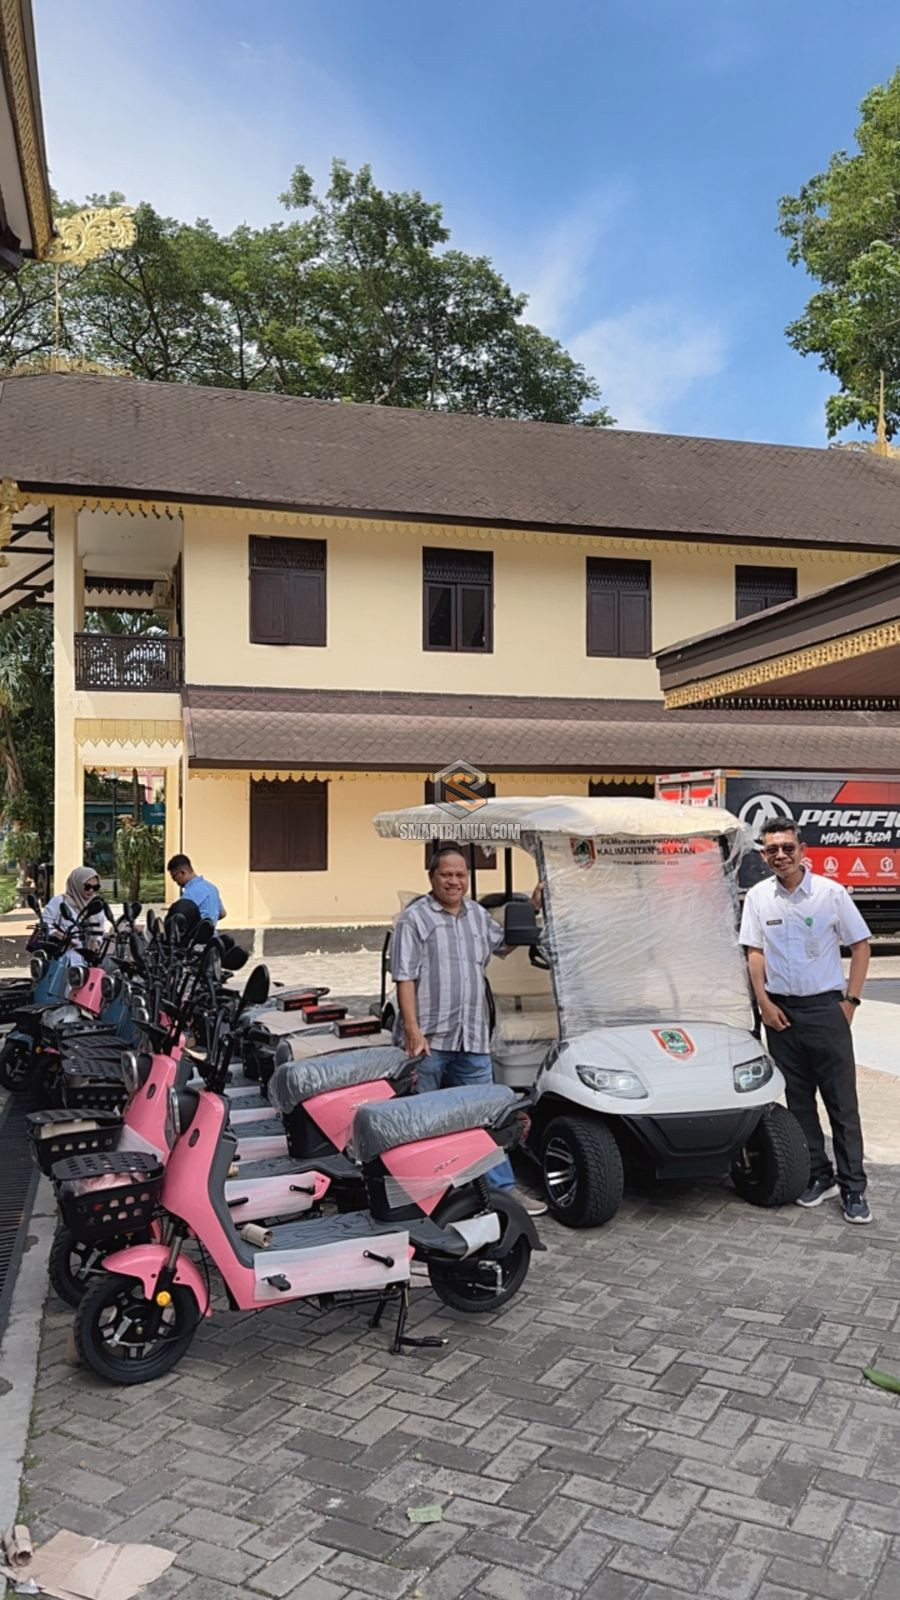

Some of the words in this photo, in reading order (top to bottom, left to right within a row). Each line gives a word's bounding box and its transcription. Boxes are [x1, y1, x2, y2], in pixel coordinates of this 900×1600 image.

[820, 830, 861, 845] MEMANG
[864, 830, 892, 843] BEDA
[597, 846, 654, 856] KALIMANTAN
[656, 847, 696, 855] SELATAN
